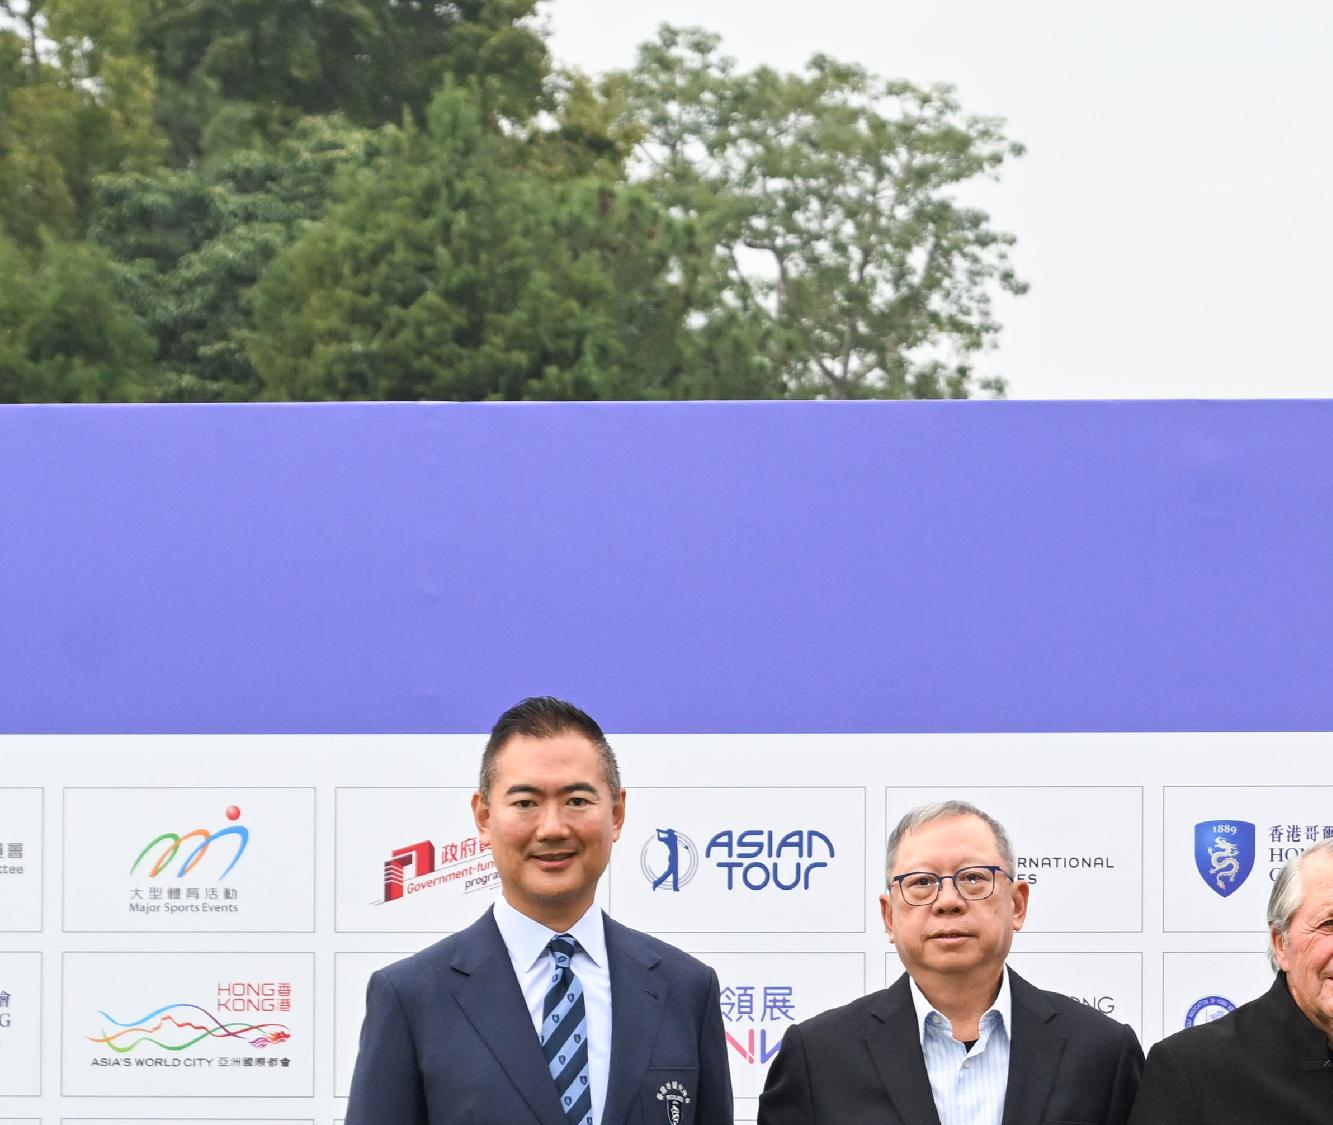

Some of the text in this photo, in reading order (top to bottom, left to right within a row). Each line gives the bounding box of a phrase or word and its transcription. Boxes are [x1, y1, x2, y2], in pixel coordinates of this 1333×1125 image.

[1212, 825, 1237, 834] 1889
[705, 830, 835, 858] ASIAN
[1018, 857, 1114, 868] RNATIONAL
[407, 861, 495, 894] Government-fun
[465, 871, 498, 890] progra
[716, 862, 828, 891] TOUR
[132, 887, 237, 899] 大型體育活動
[129, 903, 238, 914] Major Sports Events
[218, 983, 291, 996] HONG 香
[218, 999, 291, 1011] KONG 港
[91, 1057, 291, 1067] ASIA'S WORLD CITY 亞洲國際都會
